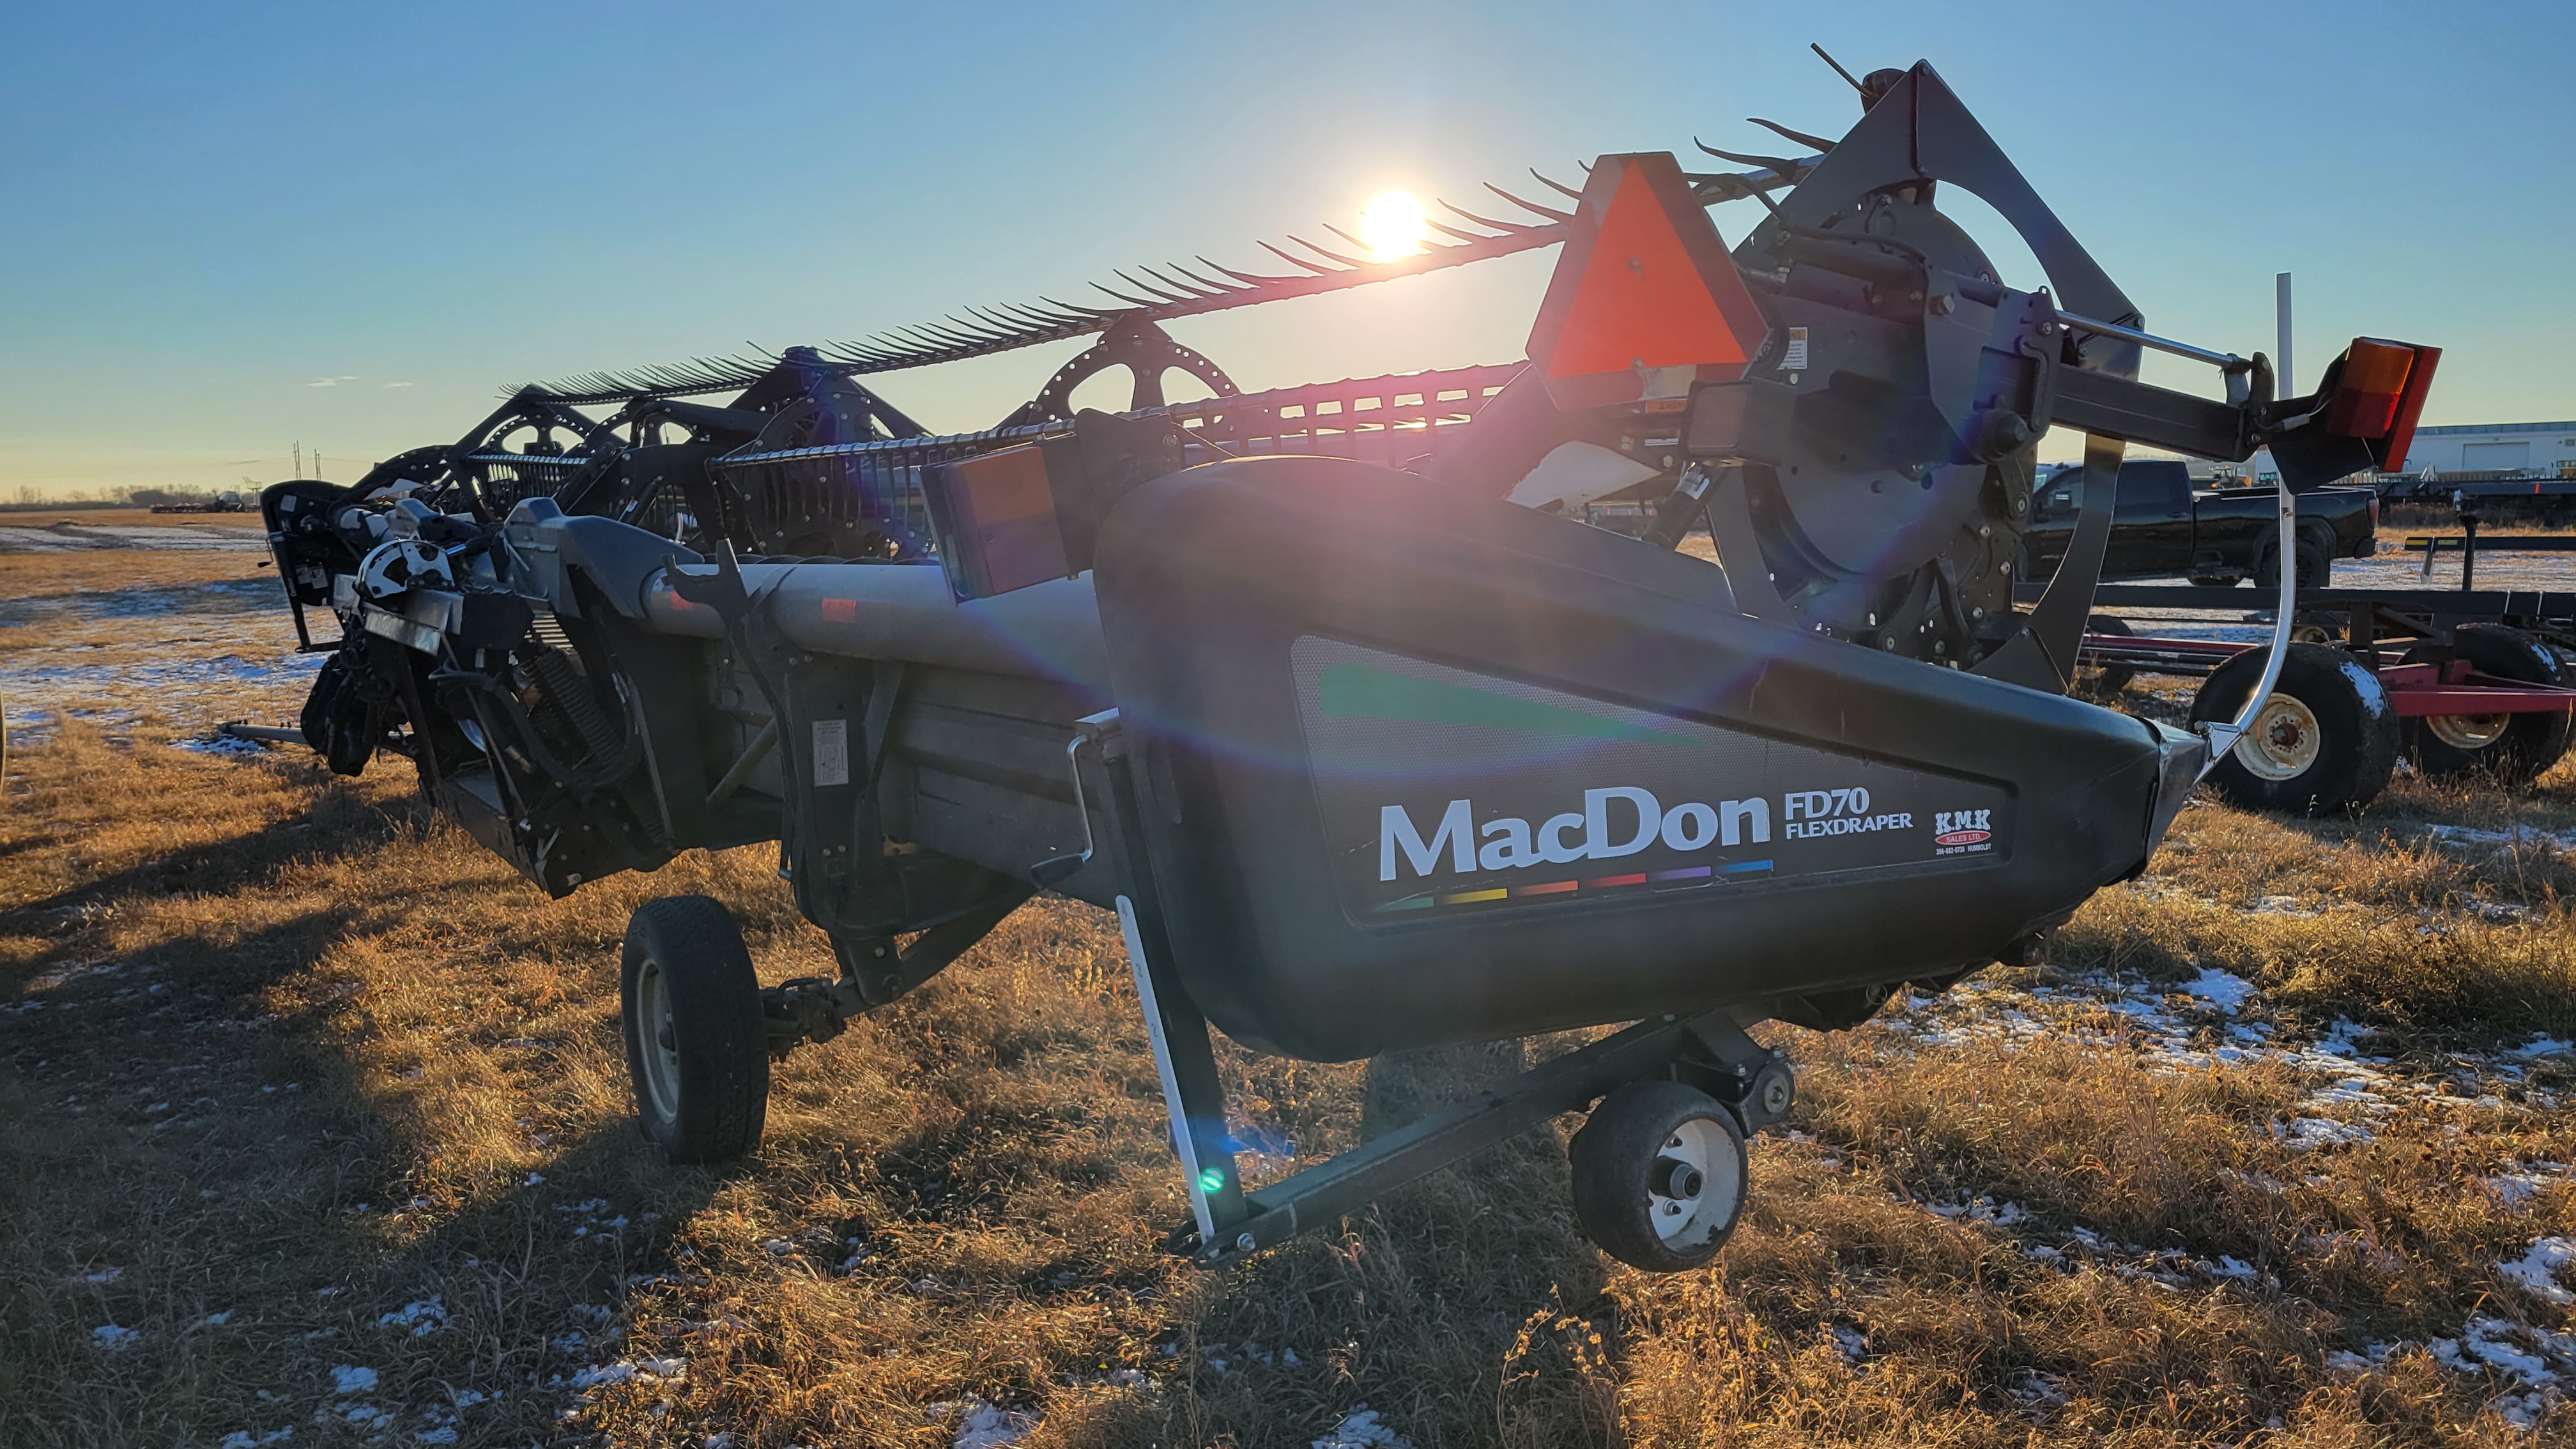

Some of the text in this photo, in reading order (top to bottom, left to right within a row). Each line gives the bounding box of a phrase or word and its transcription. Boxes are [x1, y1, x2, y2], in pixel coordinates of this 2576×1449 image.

[1785, 786, 1870, 820] FD70
[1379, 786, 1770, 882] MacDon
[1786, 813, 1913, 839] FLEXDRAPER
[1946, 834, 1967, 843] SALES
[1967, 843, 1991, 852] HUMBOLDT
[1135, 962, 1143, 978] 3
[1151, 1022, 1158, 1038] 2
